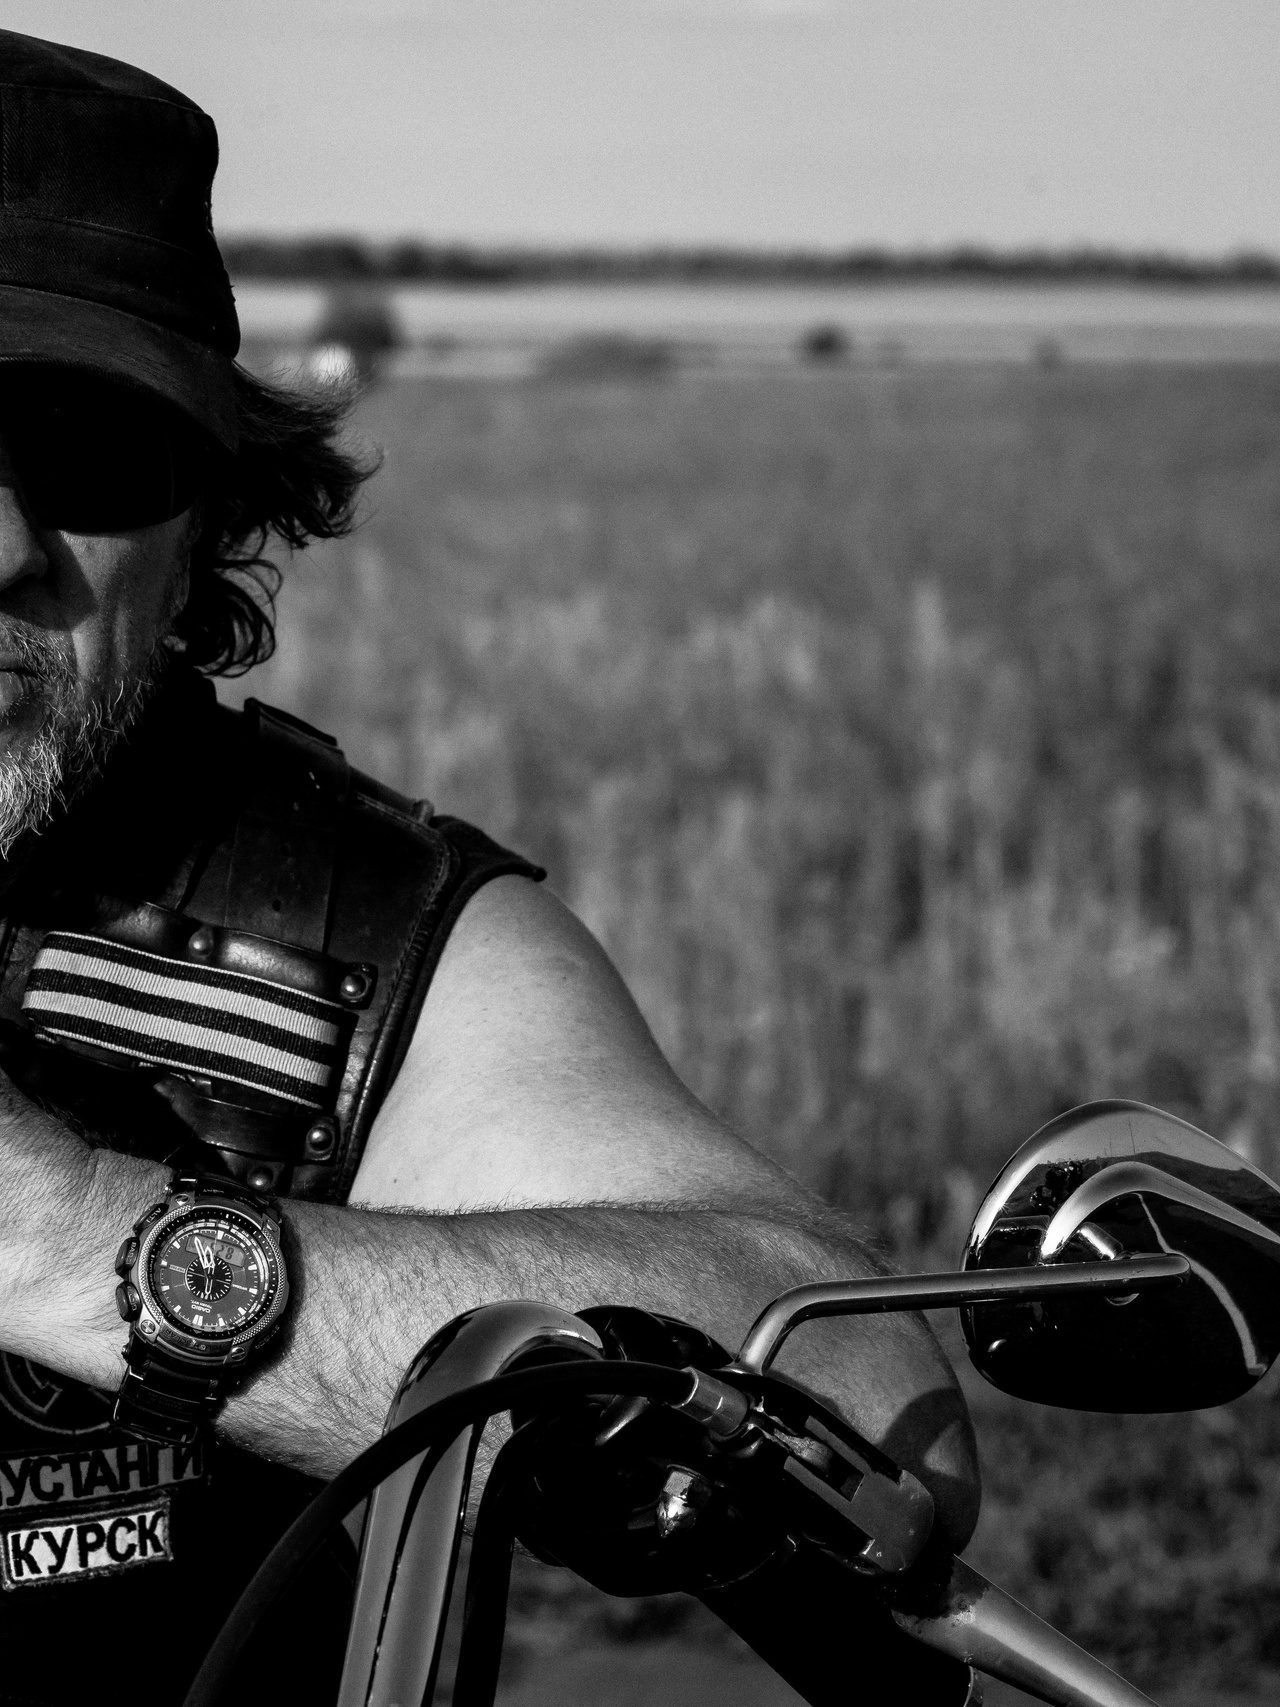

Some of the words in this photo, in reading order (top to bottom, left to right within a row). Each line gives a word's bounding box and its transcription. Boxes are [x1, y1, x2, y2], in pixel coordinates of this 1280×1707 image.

[146, 1207, 162, 1223] ALTI
[191, 1304, 211, 1314] CASIO
[11, 1511, 165, 1577] КУРСК
